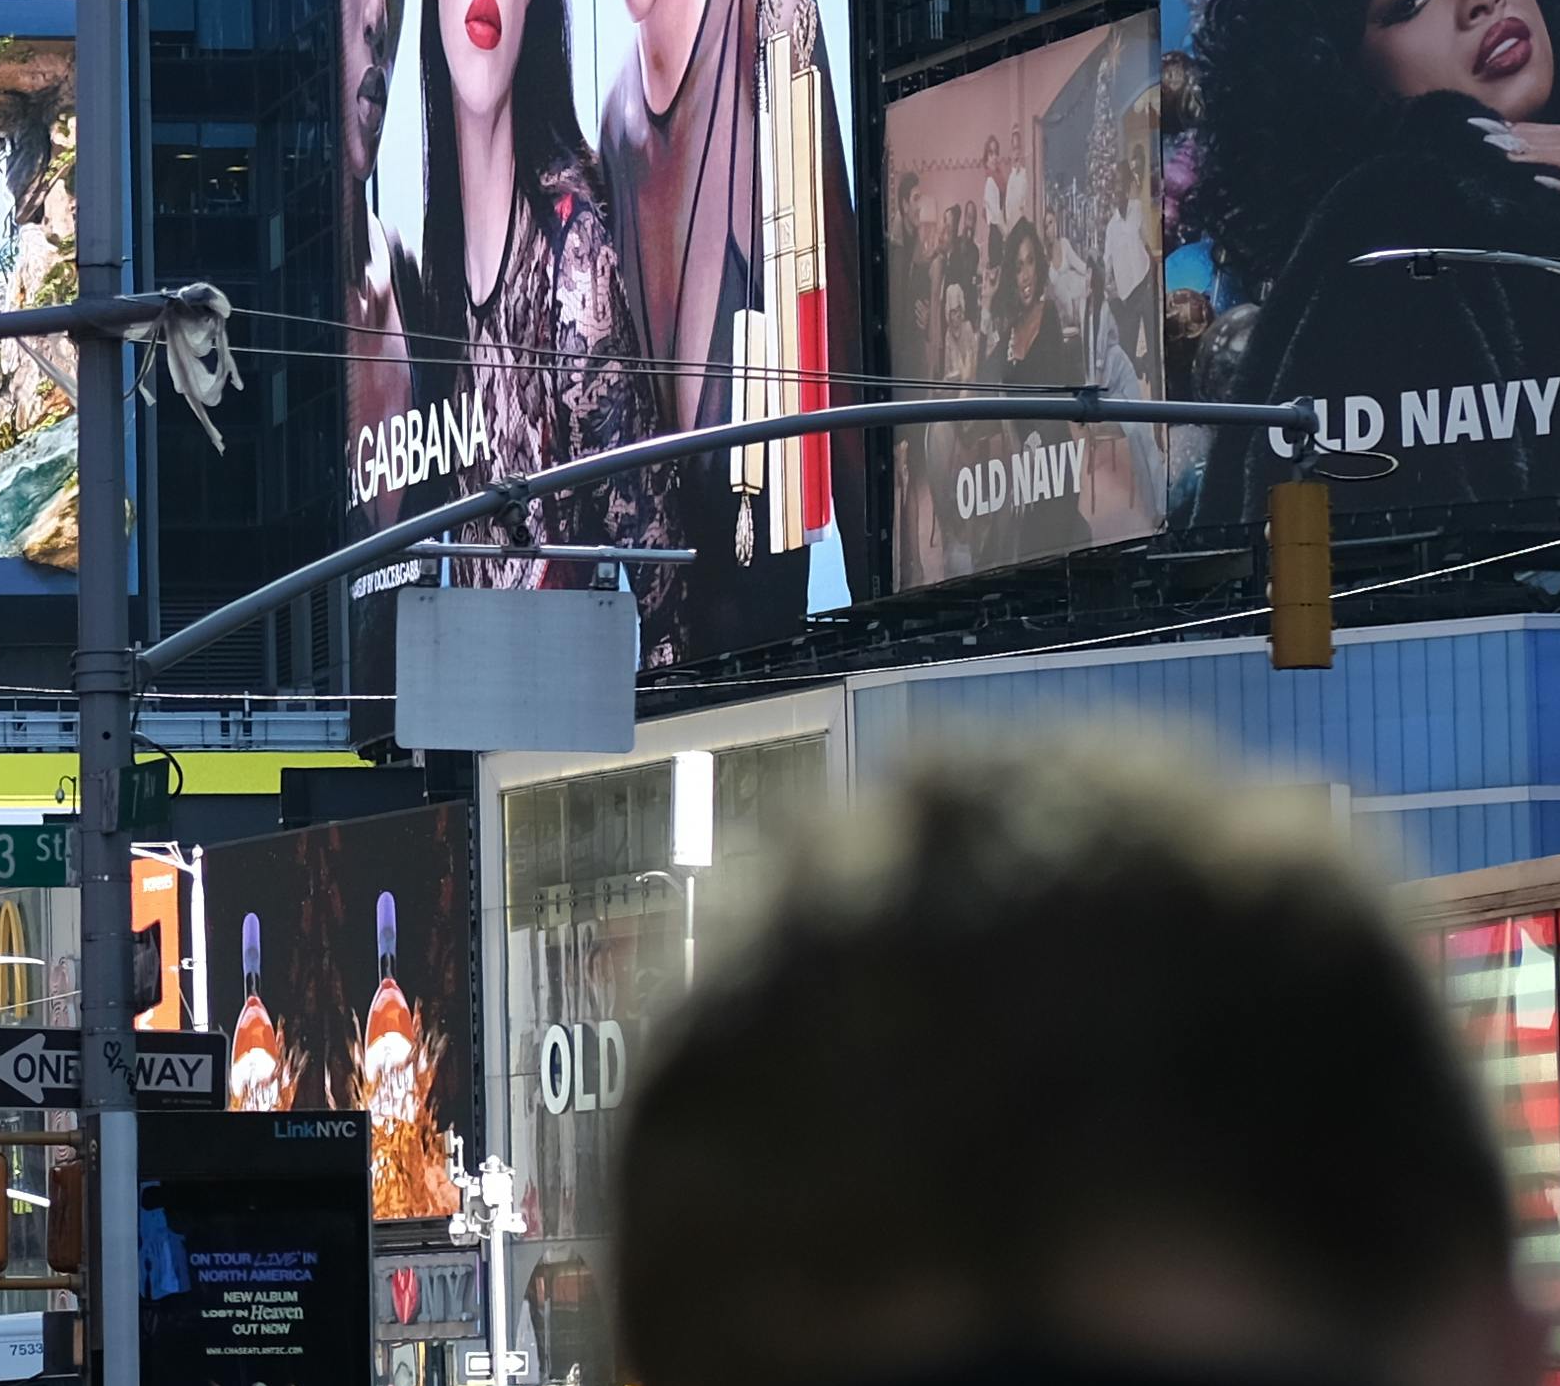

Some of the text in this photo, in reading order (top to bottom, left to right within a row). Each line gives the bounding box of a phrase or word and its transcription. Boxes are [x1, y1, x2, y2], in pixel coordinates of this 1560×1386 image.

[357, 388, 491, 503] GABBANA
[956, 437, 1085, 520] OLD NAVY
[35, 833, 63, 862] St
[540, 1018, 627, 1115] OLD
[274, 1121, 358, 1139] LinkNYC
[190, 1252, 211, 1266] ON
[214, 1252, 252, 1266] TOUR
[302, 1252, 318, 1265] IN
[198, 1268, 313, 1283] NORTH AMERICA
[223, 1290, 298, 1304] NEW ALBUM
[235, 1309, 249, 1319] IN
[250, 1304, 304, 1321] Heaven
[232, 1322, 292, 1336] OUT NOW
